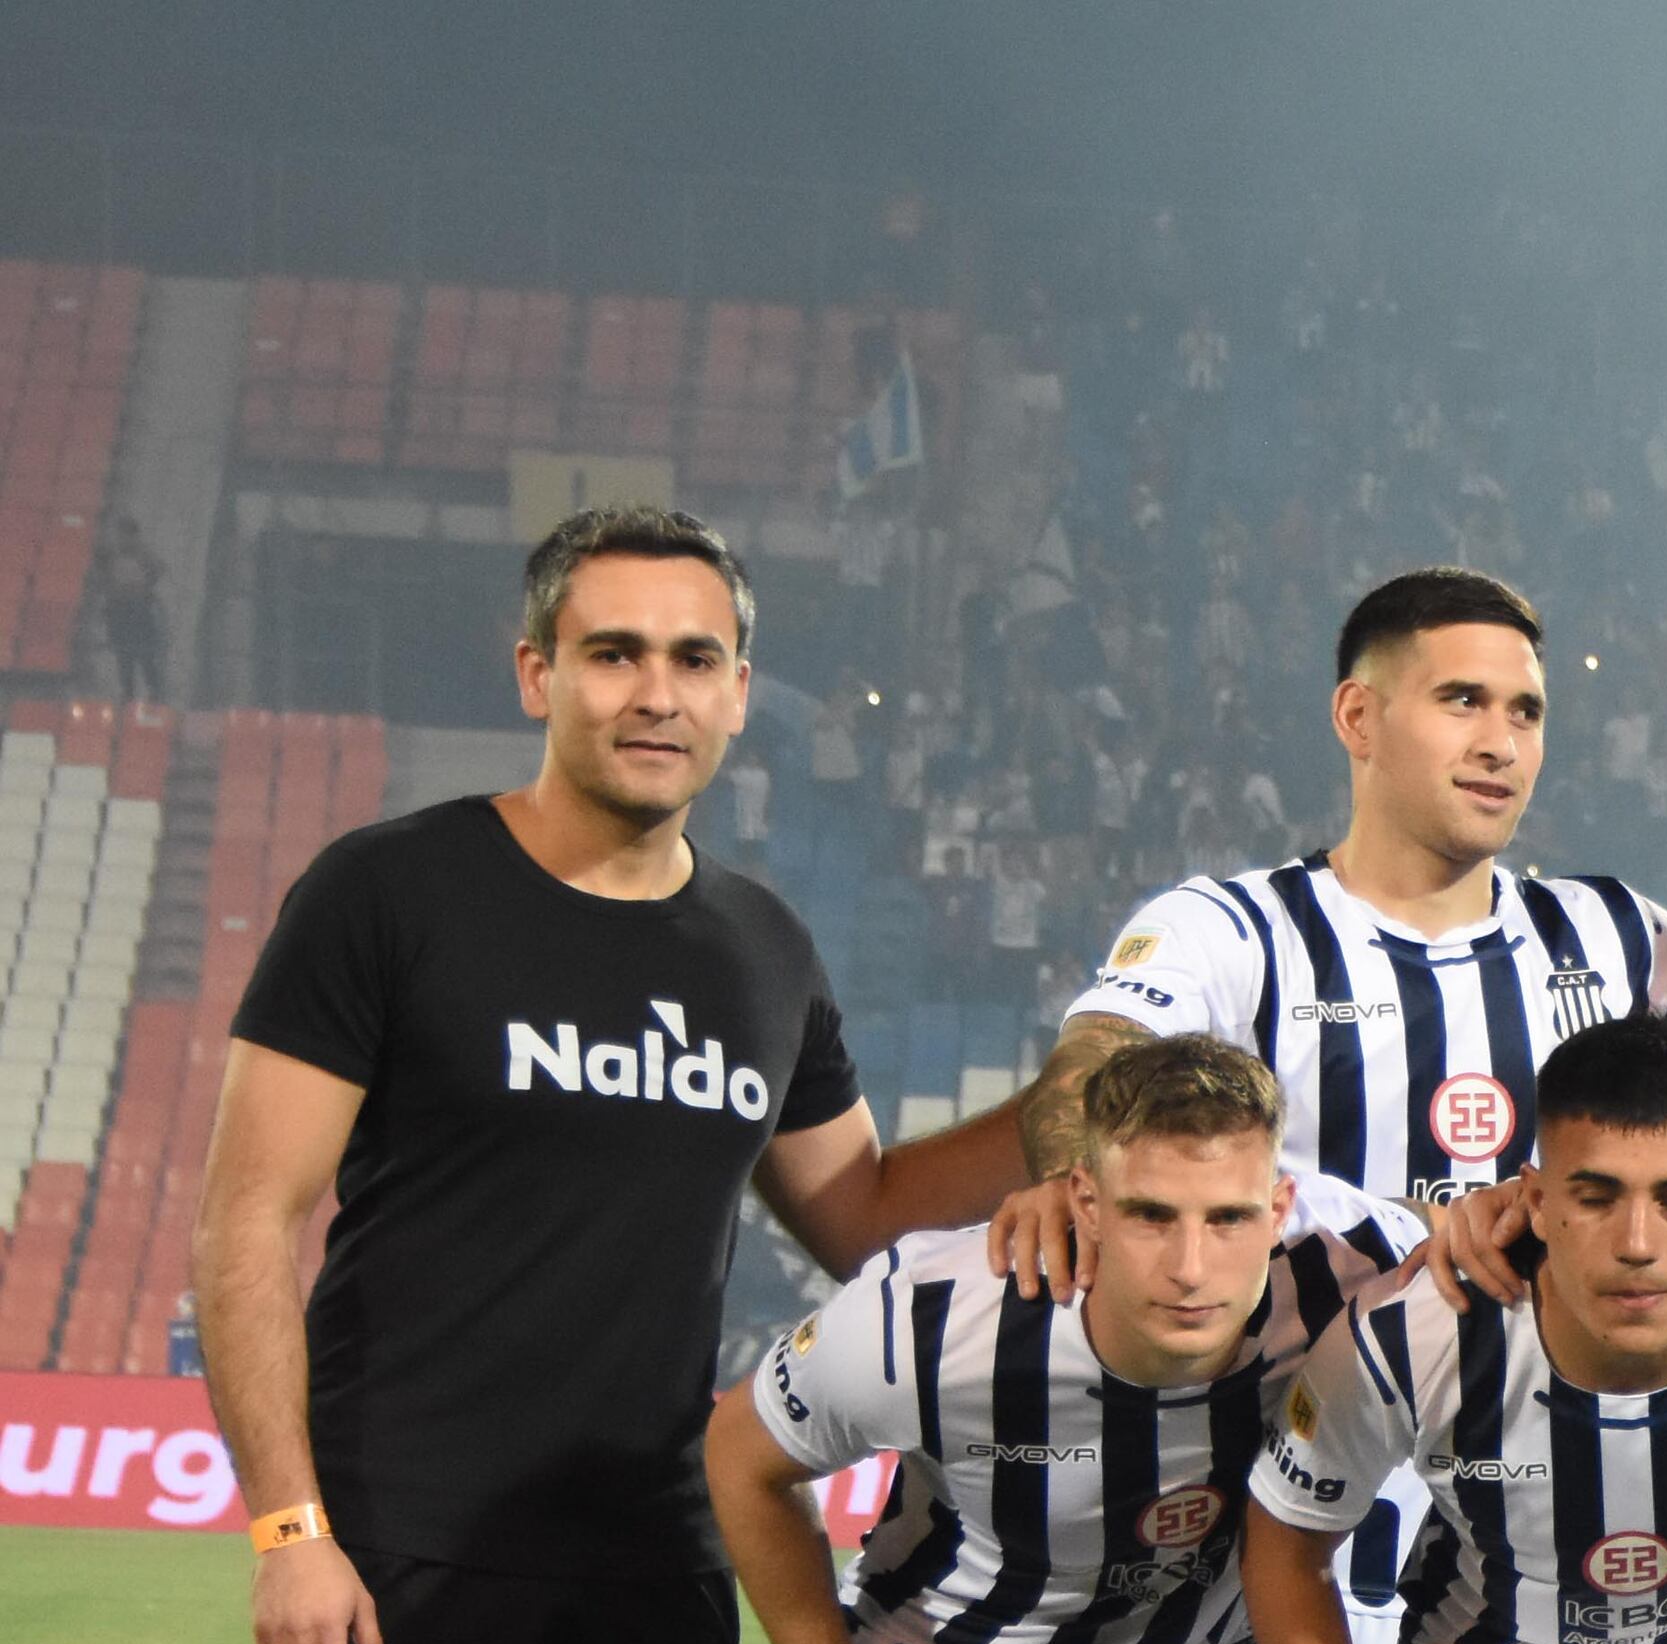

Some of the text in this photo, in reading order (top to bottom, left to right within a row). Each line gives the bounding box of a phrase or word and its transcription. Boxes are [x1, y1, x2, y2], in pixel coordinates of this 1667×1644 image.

[1558, 974, 1588, 986] C.A.T
[1291, 1002, 1397, 1022] GIVOVA
[508, 1000, 769, 1121] Naldo
[967, 1443, 1096, 1464] GIVOVA
[1427, 1454, 1547, 1480] GIVOVA
